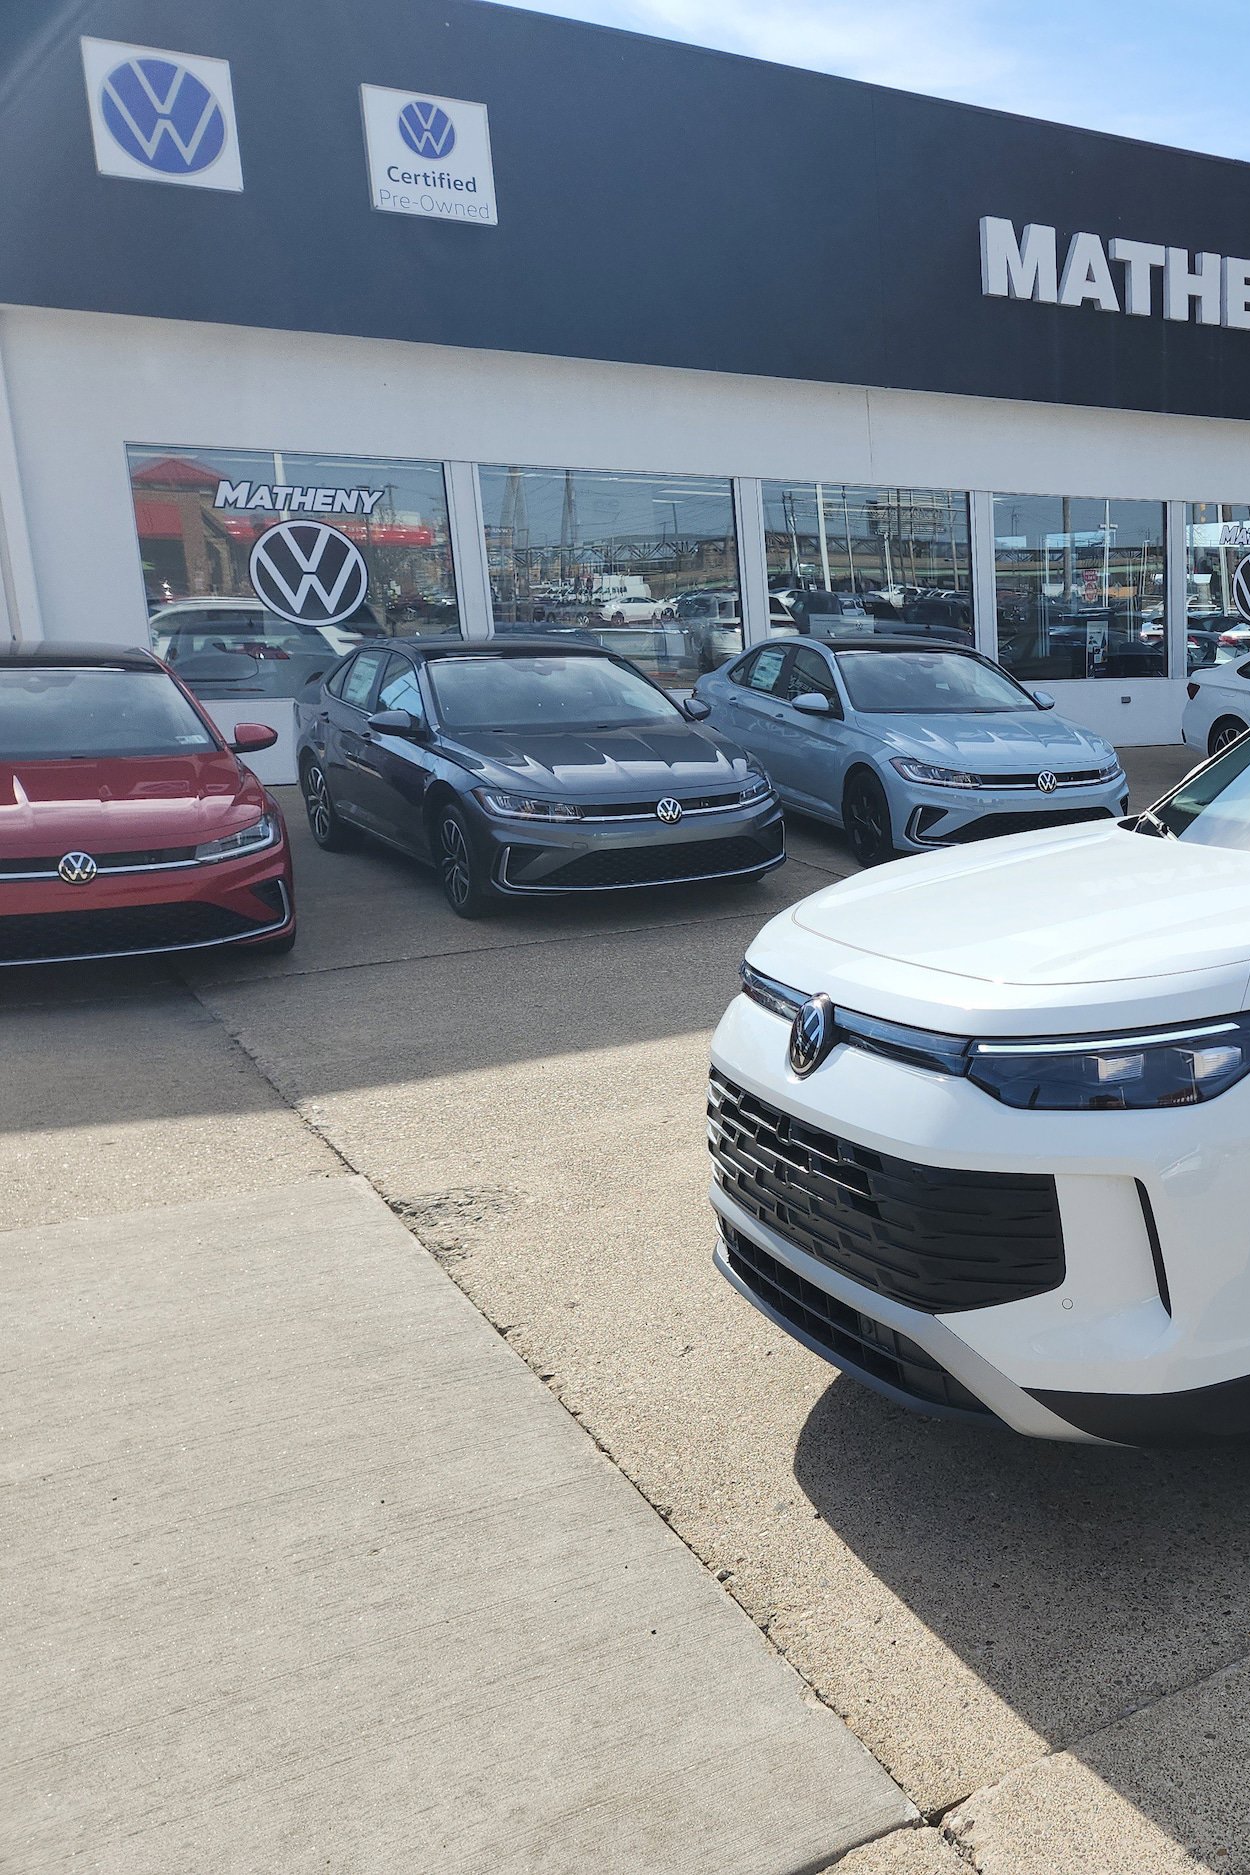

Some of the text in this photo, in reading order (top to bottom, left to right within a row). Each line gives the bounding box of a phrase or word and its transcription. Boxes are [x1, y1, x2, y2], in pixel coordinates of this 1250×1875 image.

[387, 165, 477, 192] Certified
[379, 188, 490, 219] Pre-Owned
[213, 480, 385, 515] MATHENY
